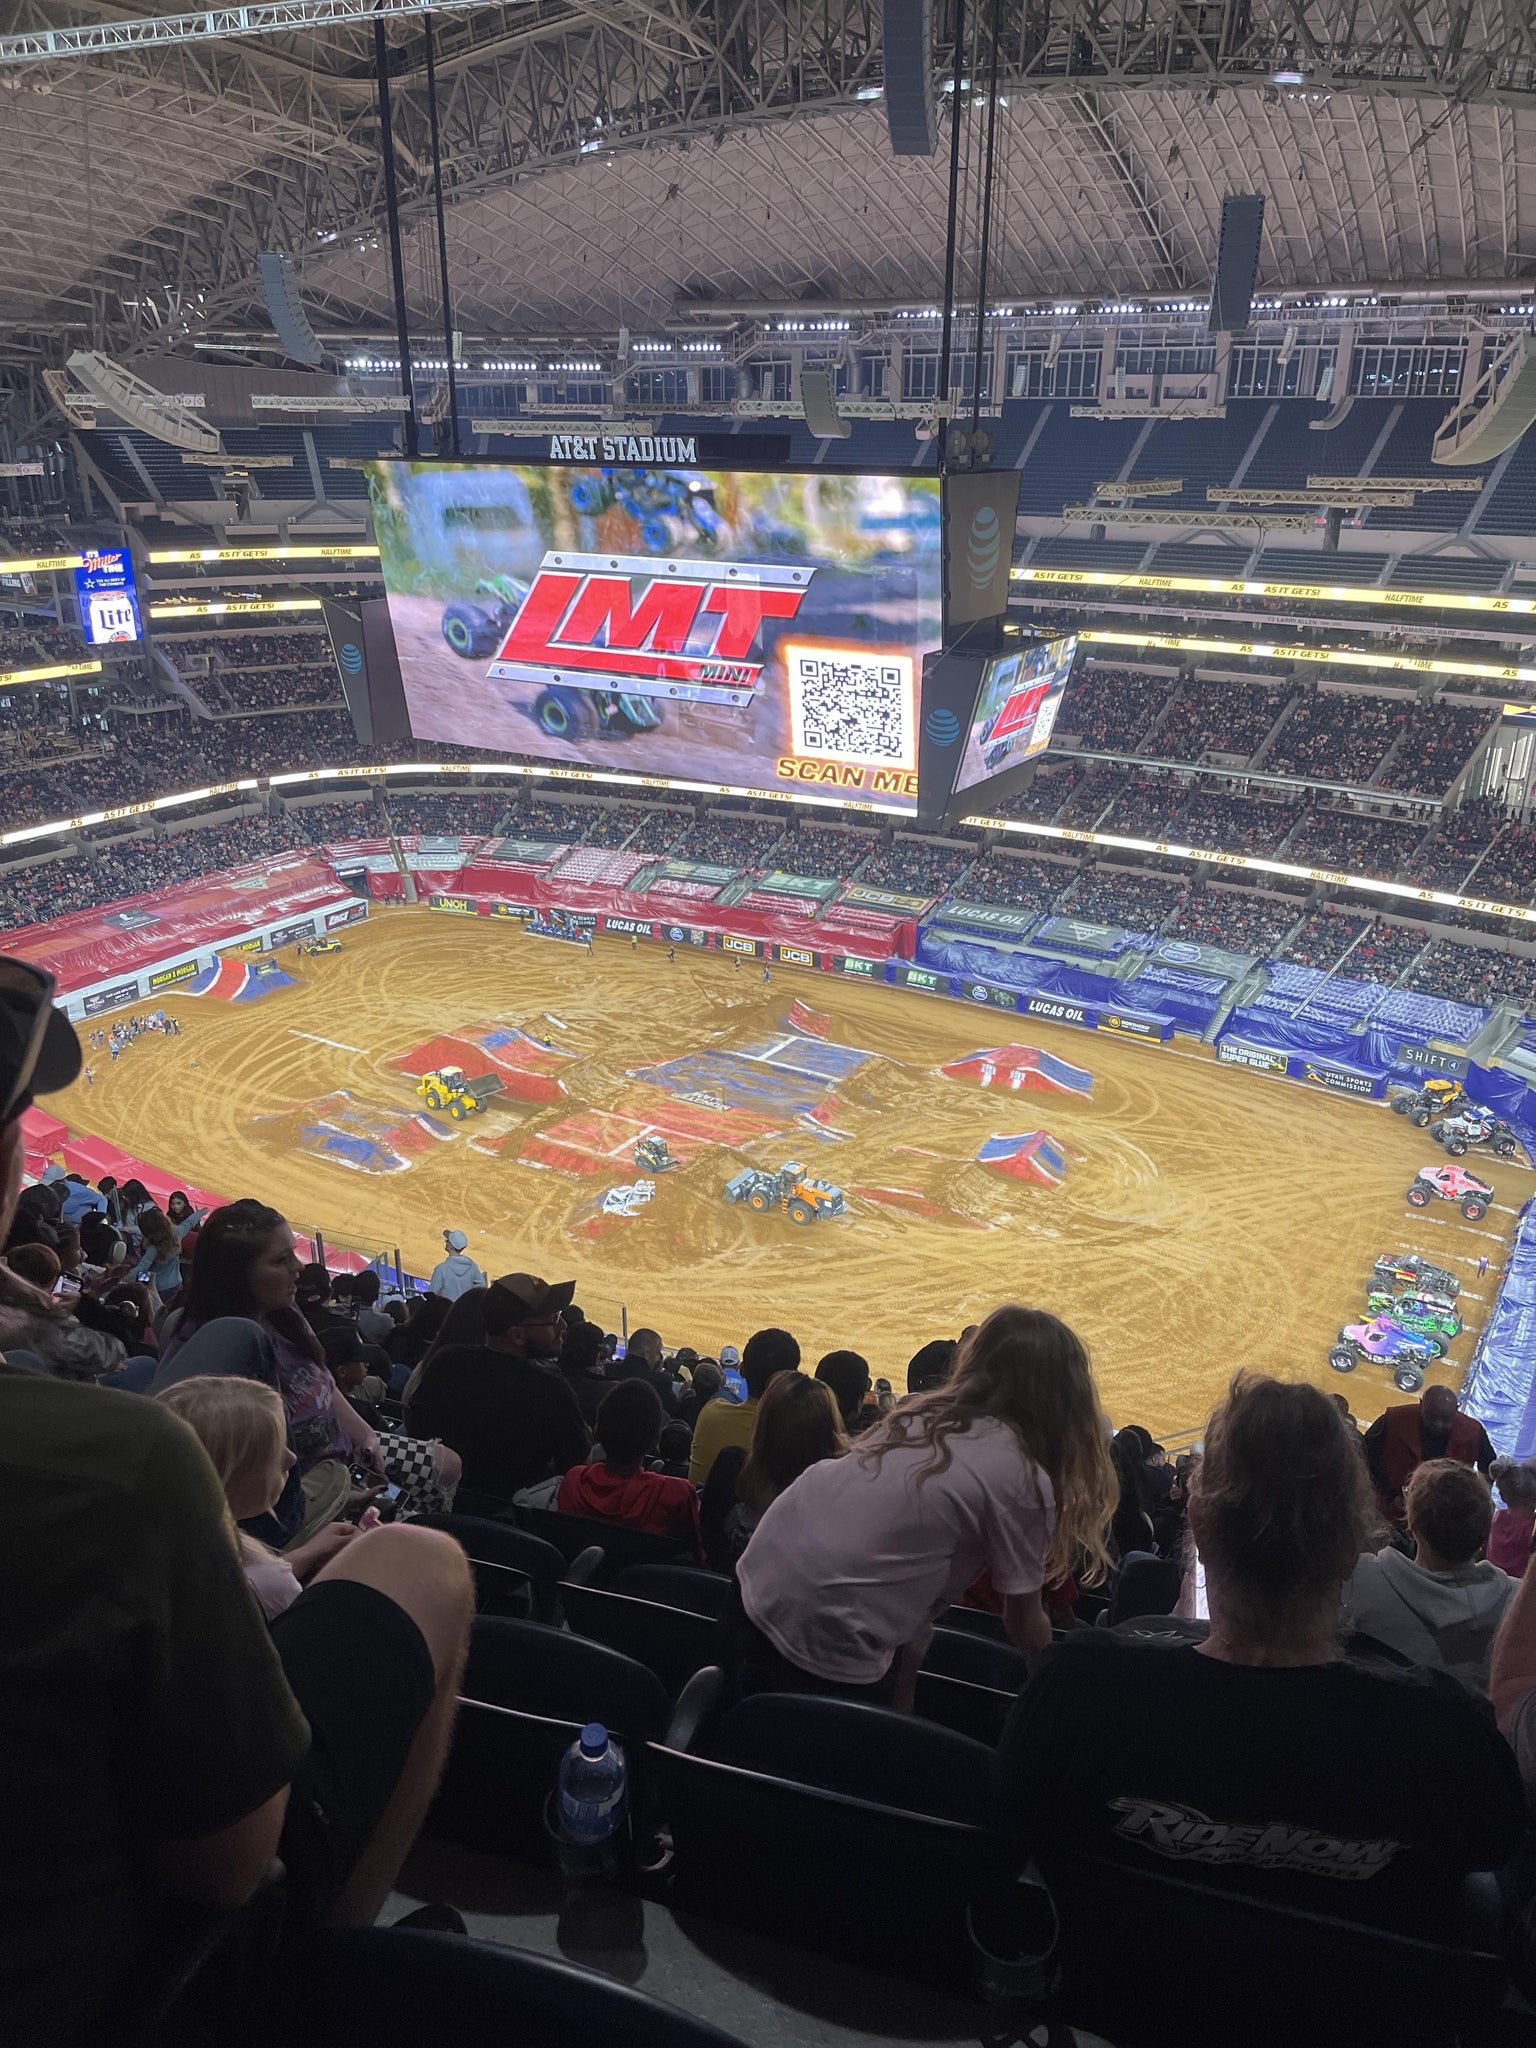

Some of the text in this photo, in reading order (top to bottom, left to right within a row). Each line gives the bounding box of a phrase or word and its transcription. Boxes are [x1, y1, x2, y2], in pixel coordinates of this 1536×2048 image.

[550, 435, 697, 464] AT&T STADIUM
[219, 550, 231, 558] AS
[36, 560, 67, 569] HALFTIME
[83, 554, 122, 573] Miller
[103, 564, 124, 573] TIME
[1046, 572, 1056, 580] IT
[1057, 573, 1083, 581] GETS!
[1139, 578, 1173, 587] HALFTIME
[1264, 586, 1278, 594] AS
[1279, 587, 1289, 595] IT
[1291, 587, 1320, 596] GETS!
[1384, 593, 1424, 604] HALFTIME
[1493, 601, 1509, 609] AS
[249, 602, 275, 610] GETS!
[99, 608, 131, 630] Lite
[498, 571, 808, 686] LMT
[1437, 628, 1457, 636] WARE
[1273, 648, 1287, 656] AS
[1287, 649, 1298, 657] IT
[1300, 650, 1329, 659] GETS!
[1502, 669, 1518, 677] AS
[698, 664, 753, 684] MINI
[776, 758, 918, 796] SCAN ME
[362, 767, 387, 775] GETS!
[440, 764, 471, 773] HALFTIME
[571, 771, 593, 779] GETS!
[641, 778, 670, 788] HALFTIME
[768, 792, 793, 800] GETS!
[843, 801, 873, 811] HALFTIME
[70, 782, 239, 828] AS AS IT GETS! HALFTIME
[968, 818, 977, 826] IT
[980, 819, 1006, 828] GETS!
[1062, 831, 1096, 841] HALFTIME
[1155, 844, 1169, 852] AS
[1188, 850, 1204, 858] AS
[1204, 851, 1215, 860] IT
[1217, 854, 1246, 865] GETS!
[1309, 871, 1350, 885] HALFTIME
[1418, 890, 1435, 900] AS
[1457, 897, 1475, 907] AS
[1475, 899, 1487, 909] IT
[1490, 903, 1528, 918] GETS!
[439, 899, 467, 910] UNOH
[948, 906, 1026, 926] LUCAS OIL
[606, 919, 652, 934] LUCAS OIL
[725, 939, 754, 952] JCB
[782, 949, 811, 963] JCB
[152, 972, 172, 985] MORGAN
[176, 963, 197, 976] MORGAN
[845, 958, 873, 973] BKT
[907, 970, 937, 986] BKT
[1028, 1000, 1064, 1017] LUCAS
[1220, 1052, 1270, 1070] SUPER GLUE
[1238, 1048, 1274, 1062] ORIGINAL
[1406, 1049, 1447, 1067] SHIFT
[1324, 1078, 1372, 1093] COMMISSION
[1326, 1071, 1372, 1088] UTAH SPORTS
